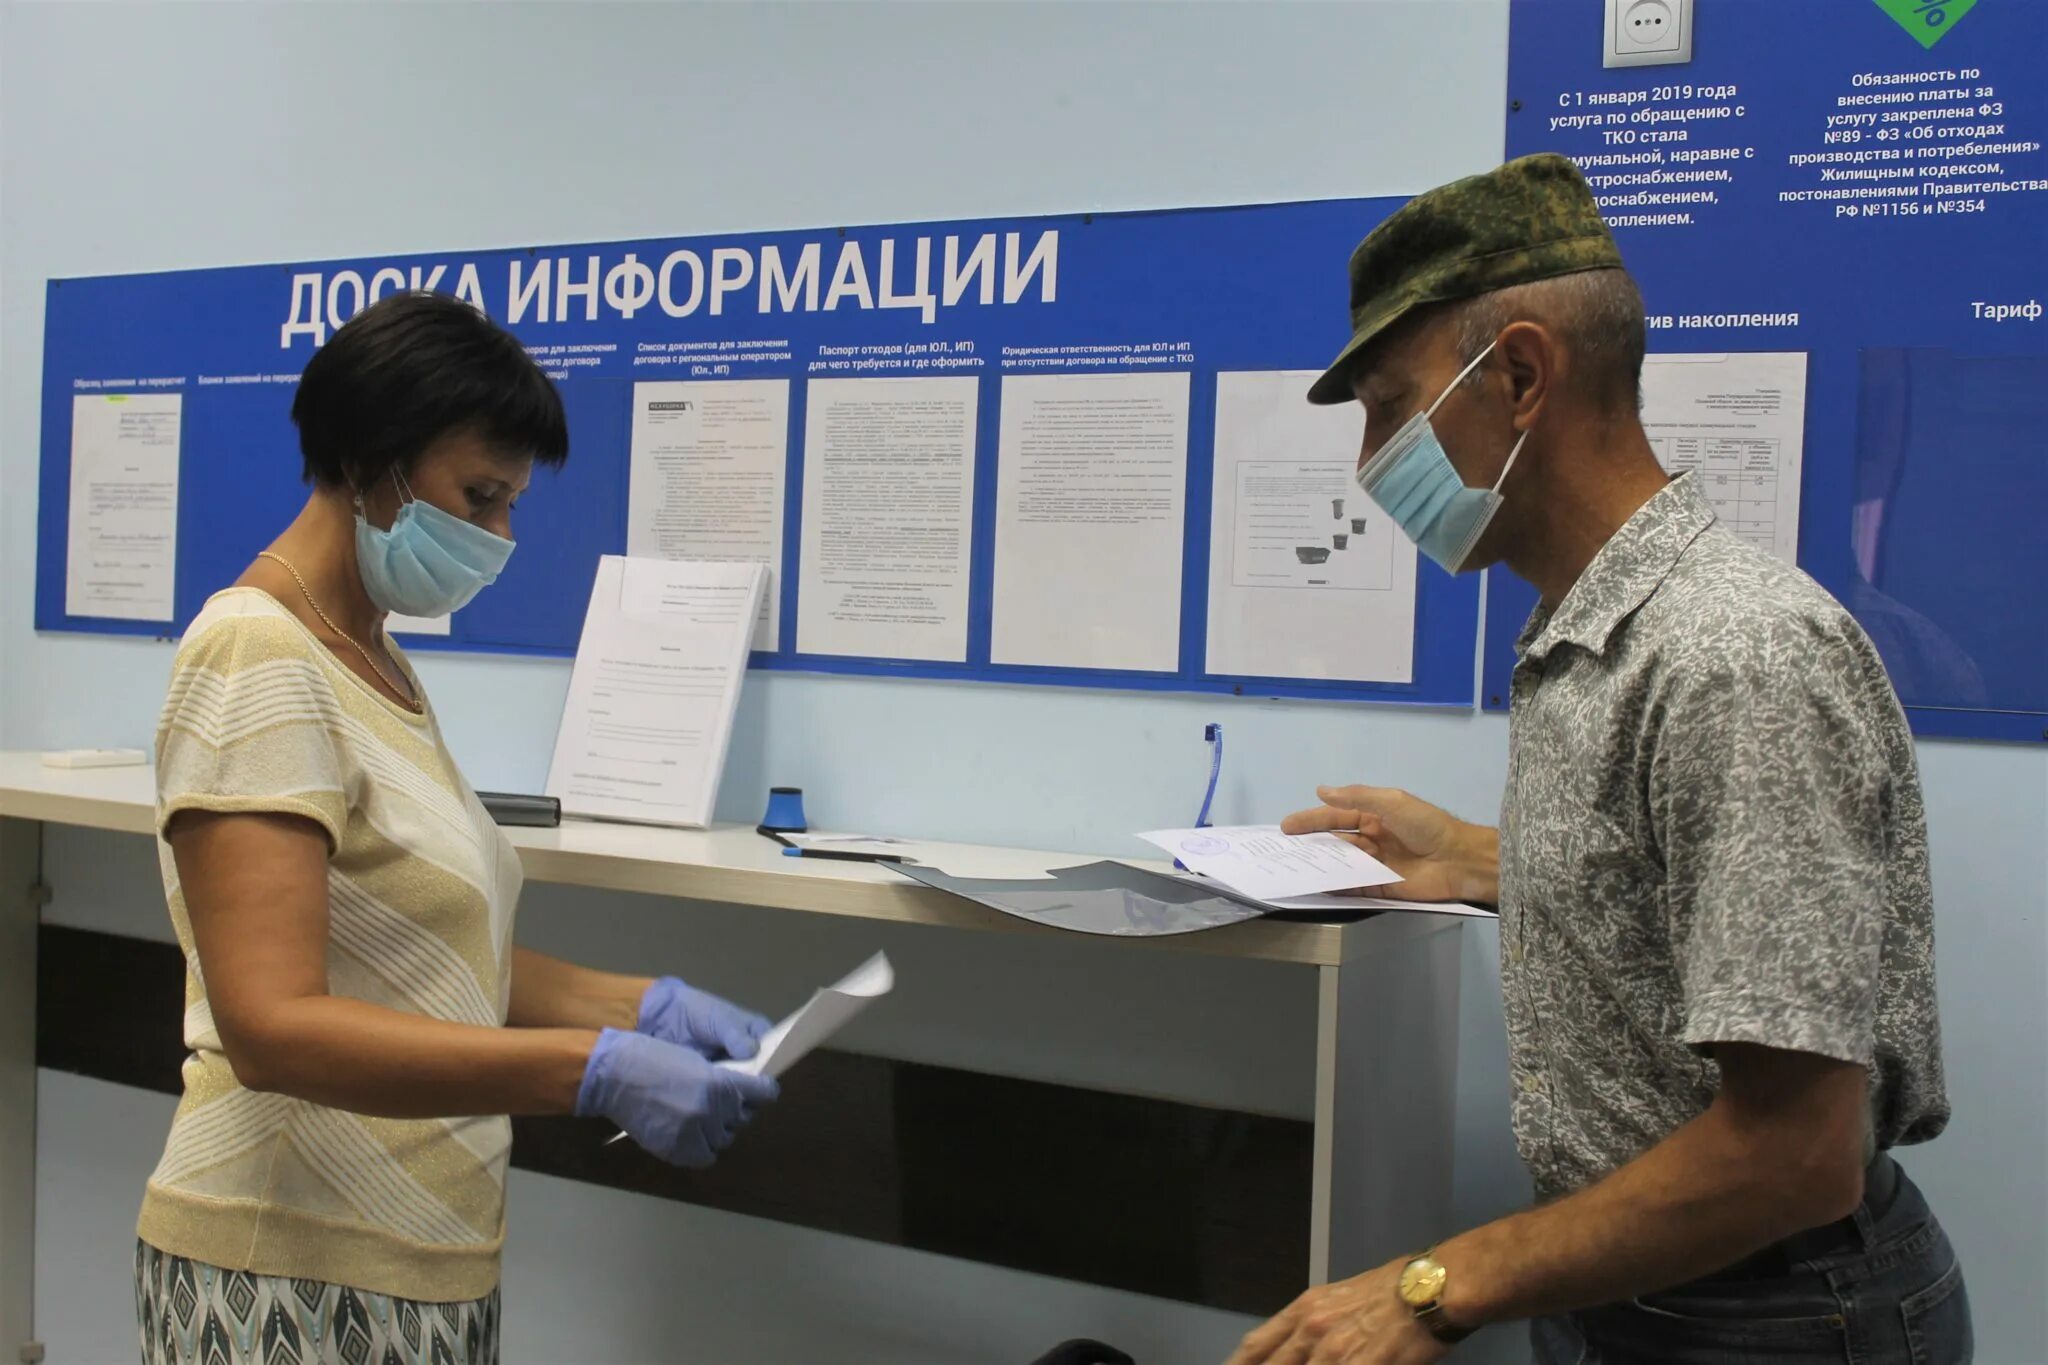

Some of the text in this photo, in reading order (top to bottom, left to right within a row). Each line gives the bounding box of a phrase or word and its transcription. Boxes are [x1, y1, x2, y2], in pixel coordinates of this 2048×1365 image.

[1852, 68, 1979, 86] Обязанность по
[1560, 85, 1736, 106] С 1 января 2019 года
[1838, 86, 1993, 106] внесению платы за
[1550, 105, 1744, 131] услуга по обращению с
[1827, 102, 2002, 128] услугу закреплена ФЗ
[1603, 130, 1687, 144] ТКО стала
[1825, 130, 1860, 144] №89
[1877, 127, 1899, 141] ФЗ
[1904, 125, 1933, 139] «Об
[1938, 124, 2004, 138] отходах
[1567, 147, 1753, 169] мунальной, наравне с
[1790, 142, 2039, 167] производства и потребеления»
[1585, 168, 1732, 189] ктроснабжением,
[1821, 163, 2003, 181] Жилищным кодексом,
[1780, 180, 2048, 202] постонавлениями Правительства
[1836, 199, 1985, 217] РФ №1156 и №354
[506, 230, 1058, 324] ИНФОРМАЦИИ
[1679, 313, 1798, 327] накопления
[1971, 300, 2042, 322] Тариф
[638, 339, 788, 352] Список документов для заключения
[819, 345, 859, 356] Паспорт
[861, 345, 902, 356] отходов
[905, 342, 927, 354] (для
[956, 340, 974, 353] ИП)
[1002, 346, 1058, 357] Юридическая
[1060, 345, 1132, 354] ответственность
[1134, 344, 1150, 354] для
[1153, 342, 1167, 352] ЮЛ
[1177, 341, 1190, 351] ИП
[634, 355, 671, 366] договора
[679, 353, 739, 365] региональным
[740, 352, 791, 363] оператором
[808, 361, 826, 372] для
[829, 360, 850, 370] чего
[852, 357, 901, 370] требуется
[912, 358, 929, 369] где
[931, 355, 984, 368] оформить
[1001, 358, 1017, 368] при
[1018, 357, 1065, 369] отсутствии
[1066, 357, 1105, 367] договора
[1107, 357, 1118, 365] на
[1119, 355, 1168, 366] обращение
[1176, 353, 1194, 363] ТКО
[714, 364, 729, 375] ИП)
